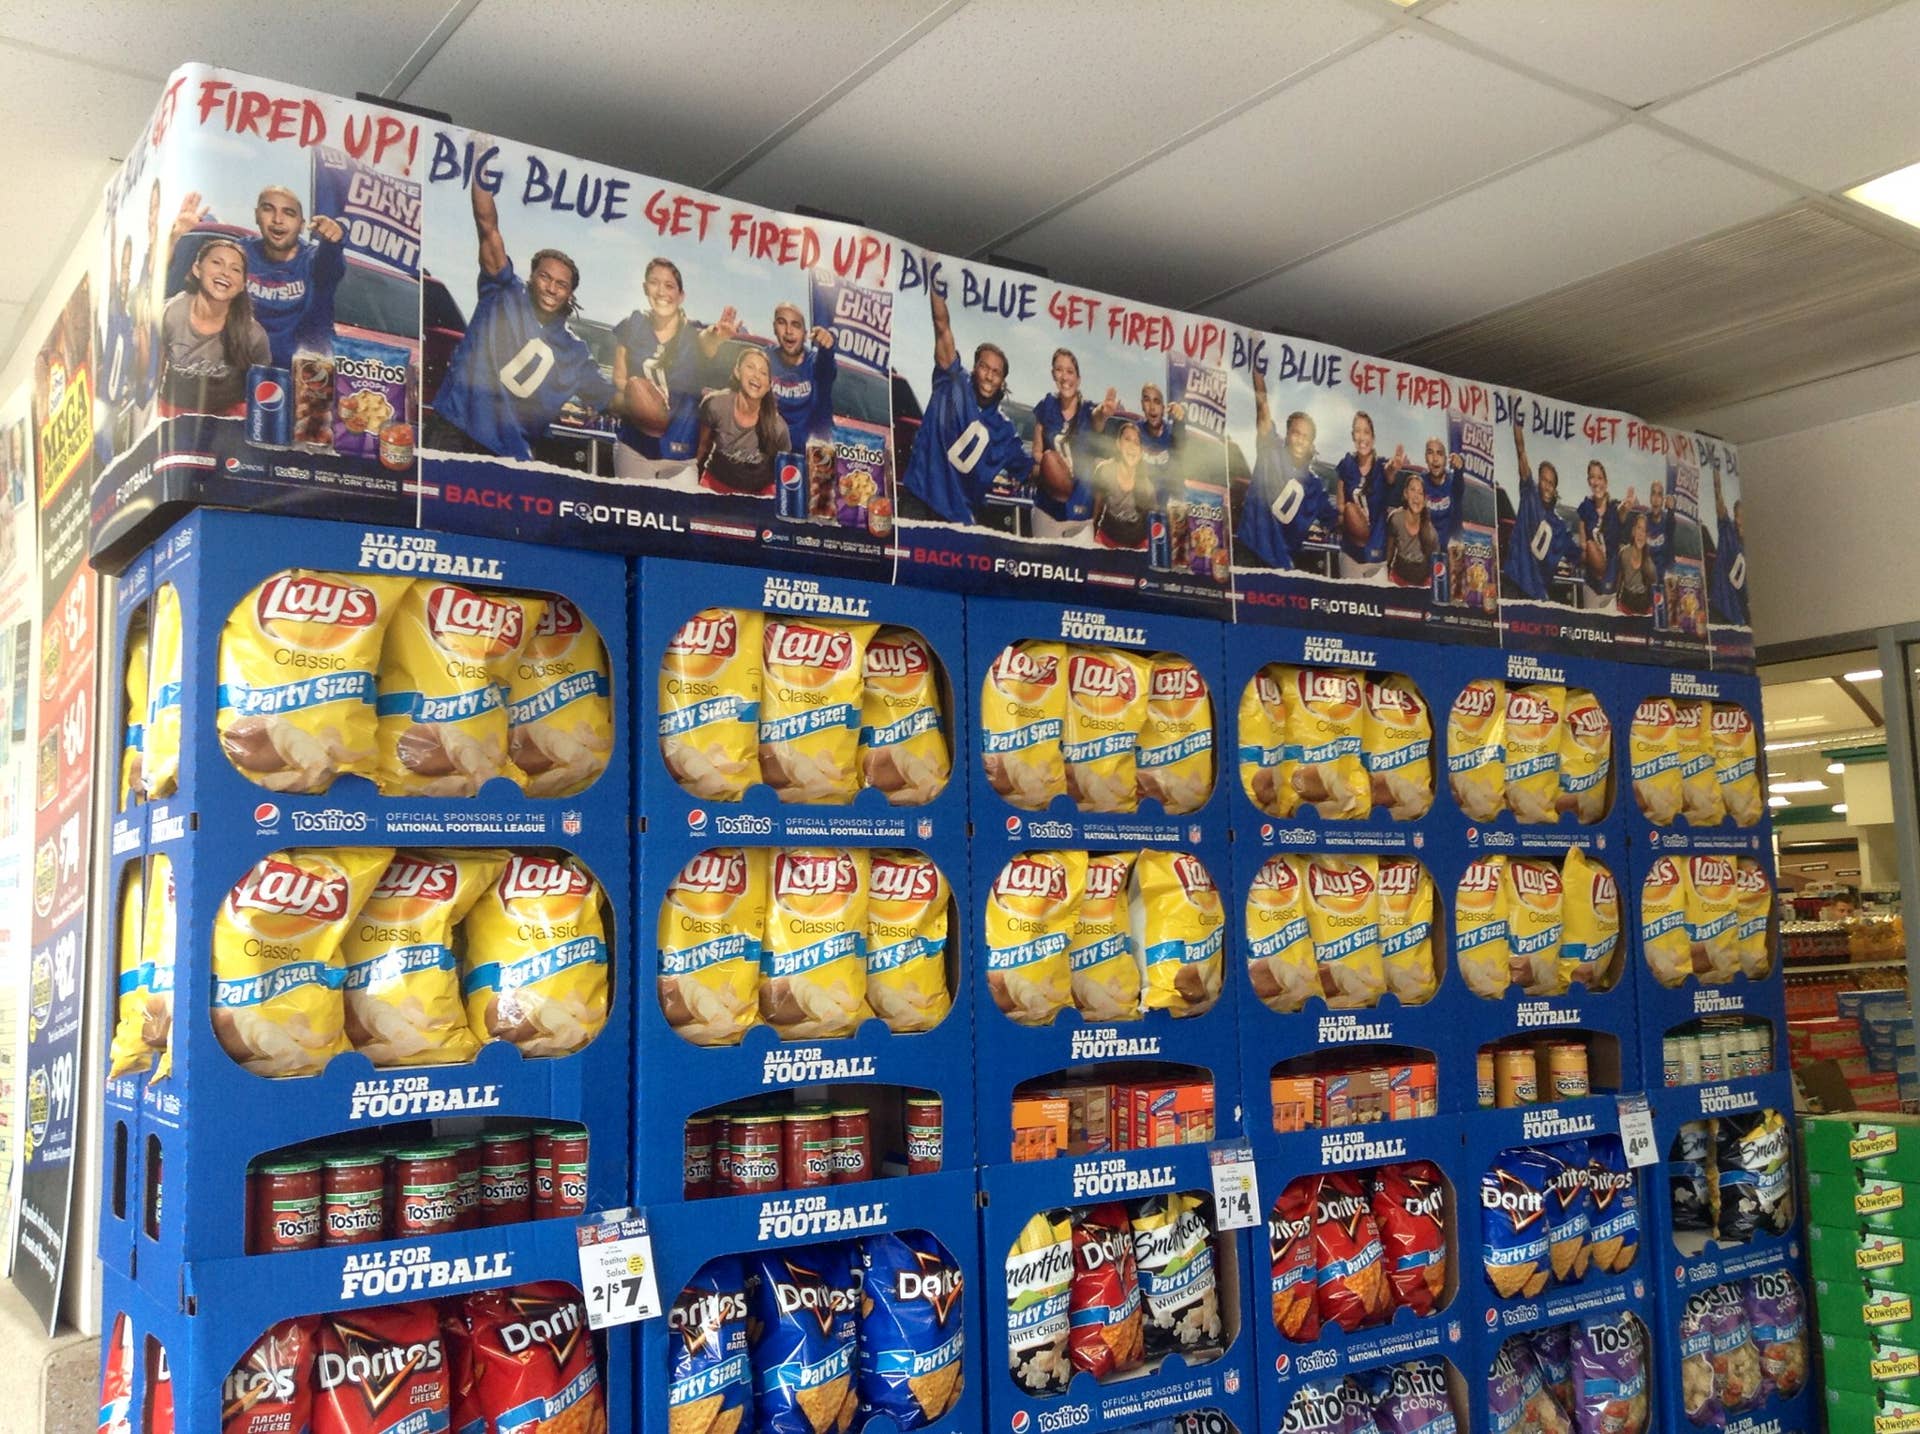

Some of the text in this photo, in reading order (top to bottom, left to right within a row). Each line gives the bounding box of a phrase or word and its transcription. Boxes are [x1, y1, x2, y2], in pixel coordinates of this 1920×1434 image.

[197, 80, 327, 148] FIRED
[343, 114, 419, 177] UP!
[429, 131, 891, 288] BIG BLUE GET FIRED UP!
[900, 248, 1225, 368] BIG BLUE GET FIRED UP!
[1231, 332, 1489, 421] BIG BLUE GET FIRED UP!
[1494, 391, 1697, 466] BIG BLUE GET FIRED UP!
[445, 484, 513, 510] BACK
[518, 493, 554, 515] TO
[361, 533, 437, 553] ALL FOR
[358, 547, 503, 579] FOOTBALL
[914, 547, 964, 570] BACK
[967, 553, 991, 571] TO
[765, 577, 819, 592] ALL FOR
[763, 588, 869, 617] FOOTBALL
[1247, 591, 1286, 608] BACK
[1288, 595, 1310, 611] TO
[1062, 611, 1105, 625] ALL FOR
[1061, 621, 1146, 645] FOOTBALL
[1305, 636, 1343, 649] ALL FOR
[274, 648, 347, 671] Classic
[1304, 646, 1377, 666] FOOTBALL
[1508, 655, 1538, 667] ALL FOR
[517, 660, 576, 681] Classic
[1508, 664, 1566, 683] FOOTBALL
[1671, 673, 1696, 684] ALL FOR
[246, 674, 364, 714] Party Size!
[509, 673, 597, 724] Party Size!
[778, 688, 829, 706] Classic
[1670, 681, 1720, 697] FOOTBALL
[421, 689, 478, 719] Party
[761, 705, 847, 741] Party Size!
[1063, 732, 1136, 762] Party Size!
[386, 812, 545, 824] OFFICIAL SPONSORS OF THE
[386, 822, 545, 833] NATIONAL FOOTBALL LEAGUE
[786, 826, 906, 838] NATIONAL FOOTBALL LEAGUE
[789, 919, 846, 935] Classic
[1327, 915, 1368, 928] Classic
[360, 924, 421, 944] Classic
[1316, 927, 1377, 961] Party Size!
[243, 938, 301, 962] Classic
[399, 947, 440, 974] Size!
[555, 938, 597, 968] Size!
[774, 936, 857, 975] Party Size!
[988, 937, 1065, 968] Party Size!
[216, 965, 317, 1004] Party Size!
[1072, 1029, 1116, 1041] ALL FOR
[1071, 1037, 1160, 1059] FOOTBALL
[352, 1077, 429, 1096] ALL FOR
[349, 1085, 499, 1119] FOOTBALL
[1321, 1132, 1364, 1147] ALL FOR
[1851, 1136, 1897, 1157] Schweppes
[1321, 1138, 1406, 1165] FOOTBALL
[760, 1197, 826, 1217] ALL FOR
[1857, 1190, 1902, 1211] Schweppes
[758, 1203, 887, 1240] FOOTBALL
[343, 1246, 430, 1272] ALL FOR
[600, 1256, 627, 1266] Tostitos
[1491, 1245, 1526, 1264] Party
[1857, 1246, 1903, 1268] Schweppes
[341, 1252, 512, 1299] FOOTBALL
[606, 1269, 626, 1278] Salsa
[1152, 1269, 1188, 1294] Party
[1155, 1293, 1186, 1310] WHITE
[1864, 1302, 1910, 1323] Schweppes
[318, 1339, 442, 1390] Doritos
[1871, 1358, 1918, 1379] Schweppes
[410, 1391, 441, 1404] CHEESE
[411, 1383, 439, 1394] NACHO
[247, 1421, 291, 1434] CHEESE
[251, 1413, 291, 1424] NACHO
